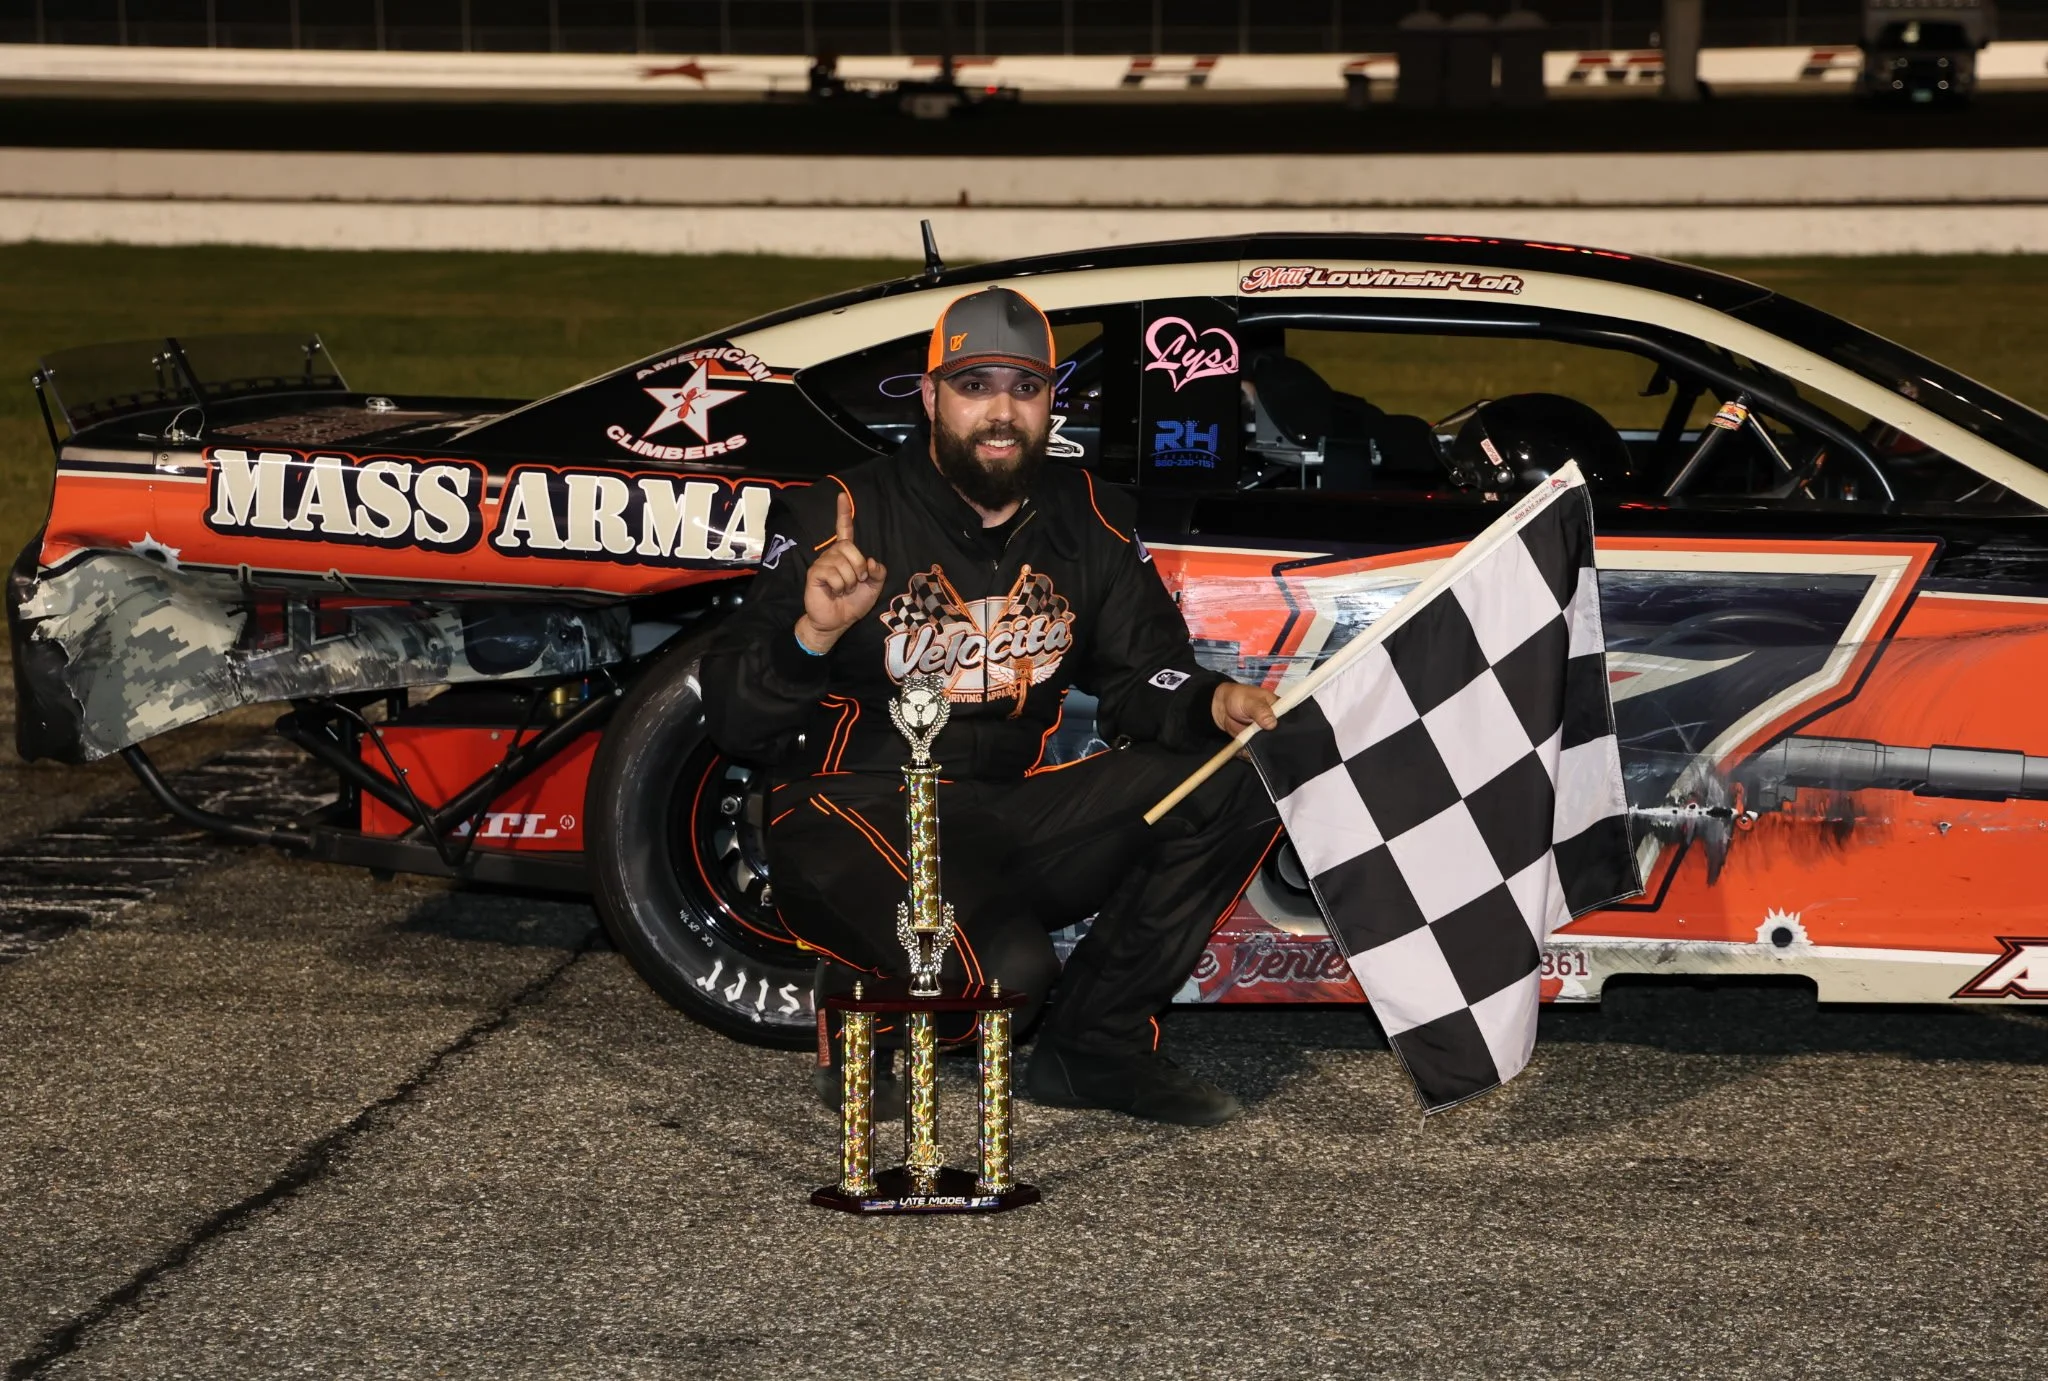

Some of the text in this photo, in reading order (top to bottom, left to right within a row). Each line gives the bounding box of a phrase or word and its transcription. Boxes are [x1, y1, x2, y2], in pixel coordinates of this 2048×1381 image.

[1243, 267, 1521, 294] Matt Lowinski-Loh
[636, 347, 773, 382] AMERICAN
[1145, 334, 1239, 379] Lyss
[606, 425, 748, 461] CLIMBERS
[1155, 420, 1219, 453] RH
[210, 449, 471, 545] MASS
[886, 615, 1071, 679] Velocita
[696, 958, 815, 1022] sier
[900, 1197, 926, 1206] LATE
[928, 1196, 967, 1205] MODEL
